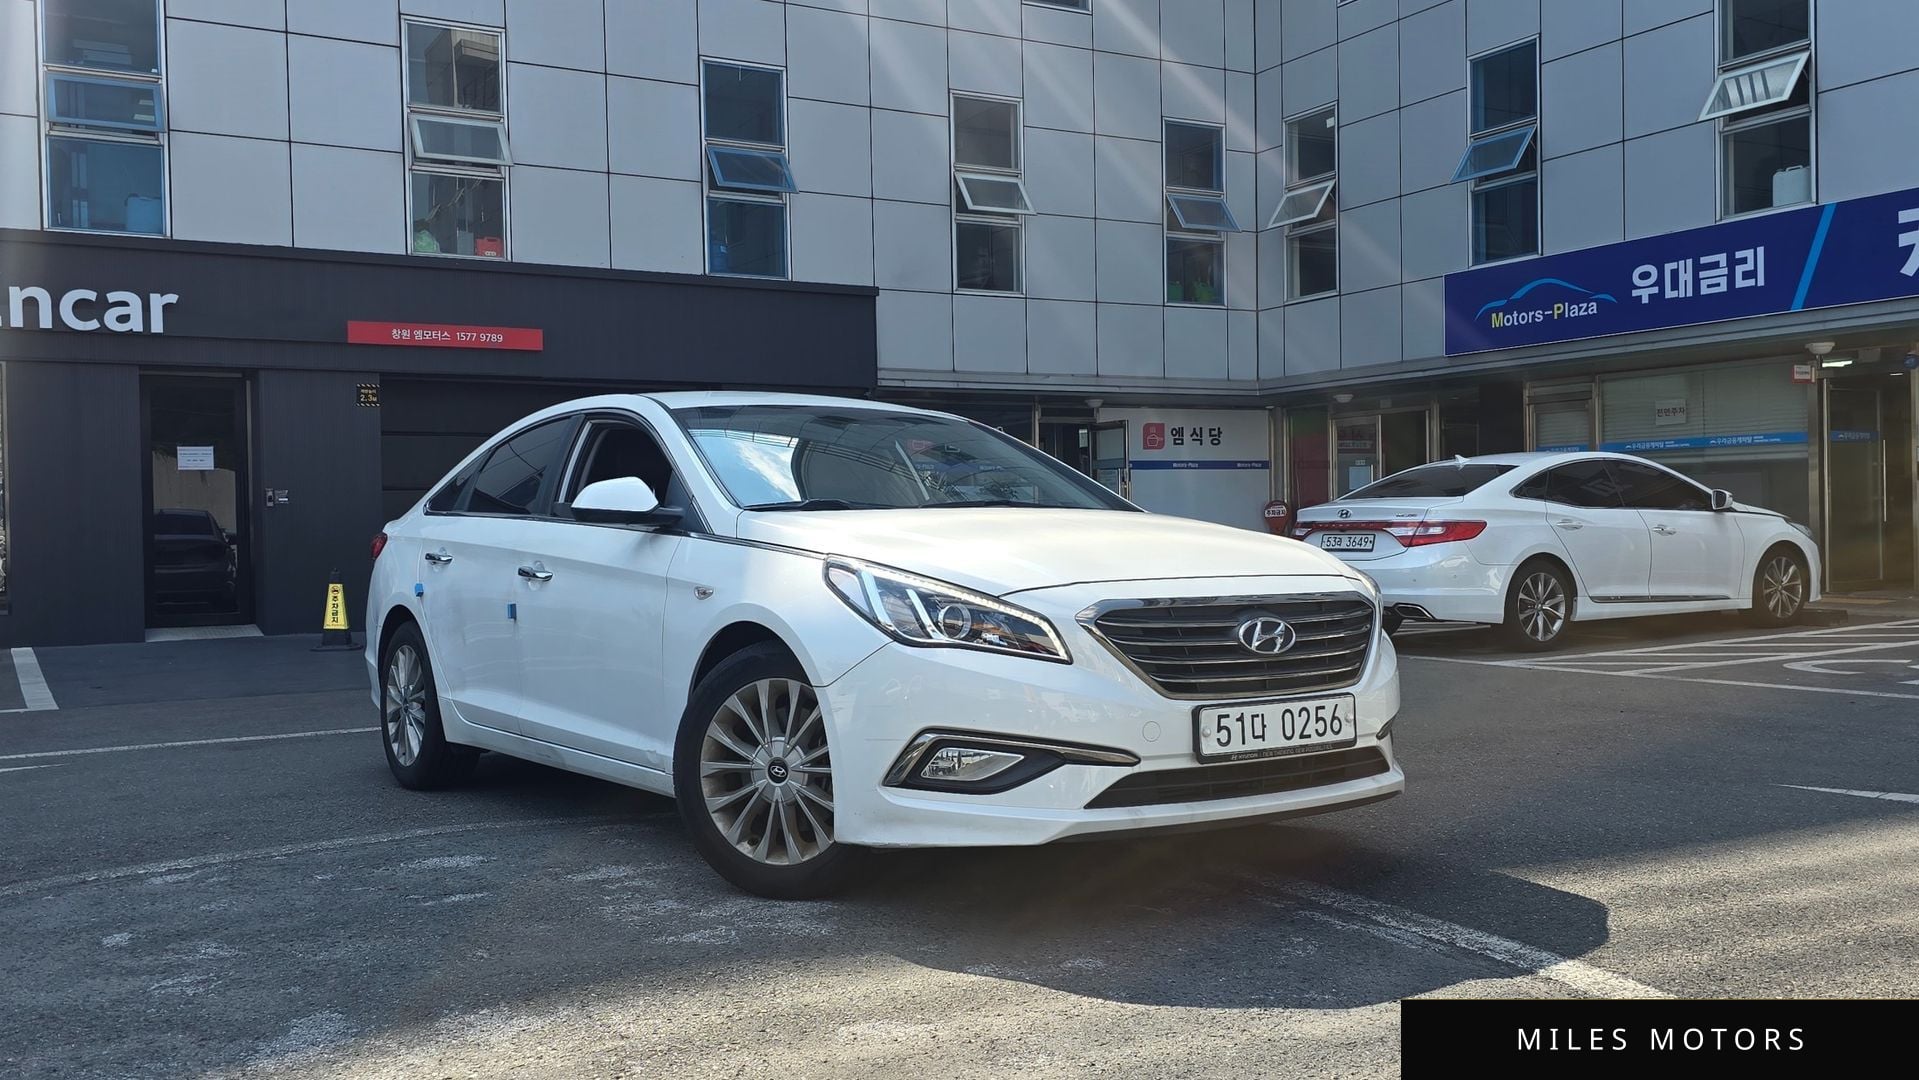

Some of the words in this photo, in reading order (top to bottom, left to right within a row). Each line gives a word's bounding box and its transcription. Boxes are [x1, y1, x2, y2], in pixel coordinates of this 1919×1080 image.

[1631, 246, 1766, 304] 우대금리
[0, 286, 179, 334] ncar
[1490, 300, 1599, 329] Motors-Plaza
[391, 328, 411, 340] 창원
[413, 329, 451, 341] 엠모터스
[456, 332, 477, 342] 1577
[479, 333, 503, 343] 9789
[1345, 536, 1369, 548] 3649
[331, 595, 339, 624] 주차금지
[1281, 703, 1342, 741] 0256
